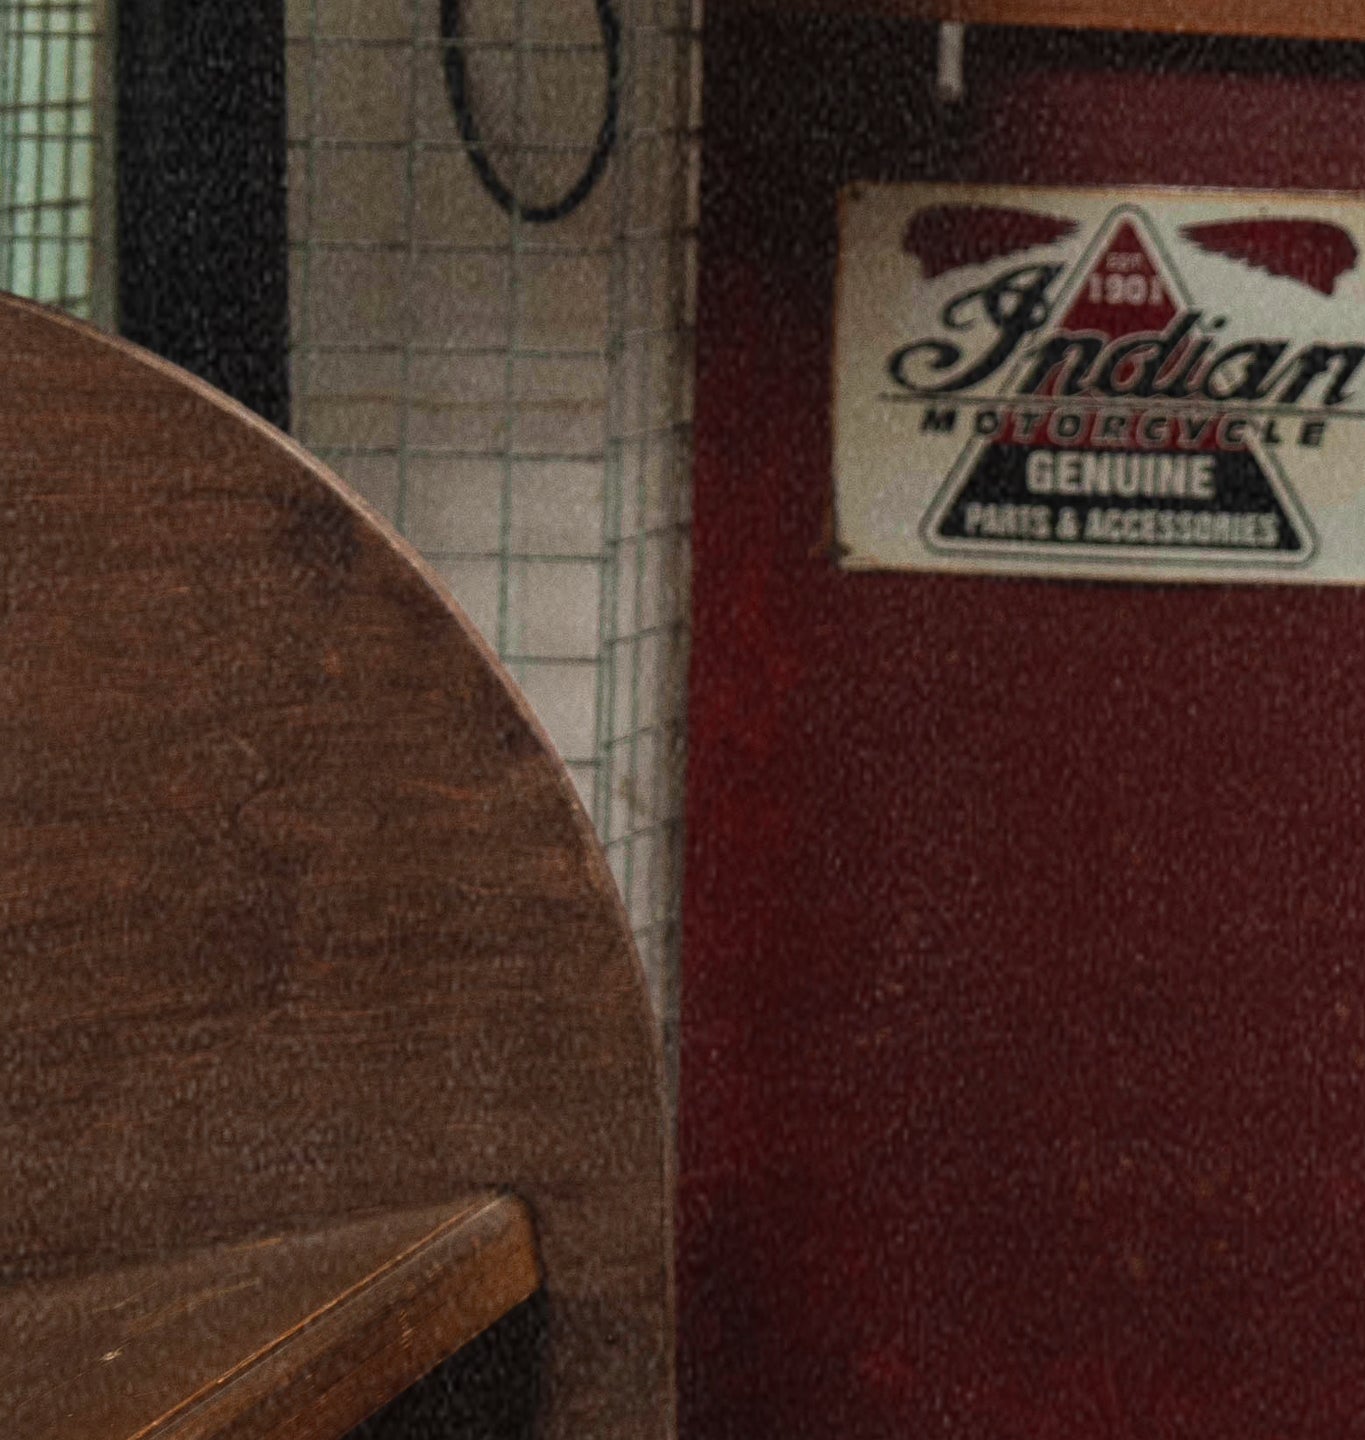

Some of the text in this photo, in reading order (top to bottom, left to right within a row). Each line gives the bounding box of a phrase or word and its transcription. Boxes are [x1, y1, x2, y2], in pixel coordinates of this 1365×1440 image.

[919, 406, 1328, 450] MOTORCYCLE
[1024, 449, 1217, 500] GENUINE
[964, 502, 1052, 540] PARTS
[1084, 506, 1281, 547] ACCESSORIES
